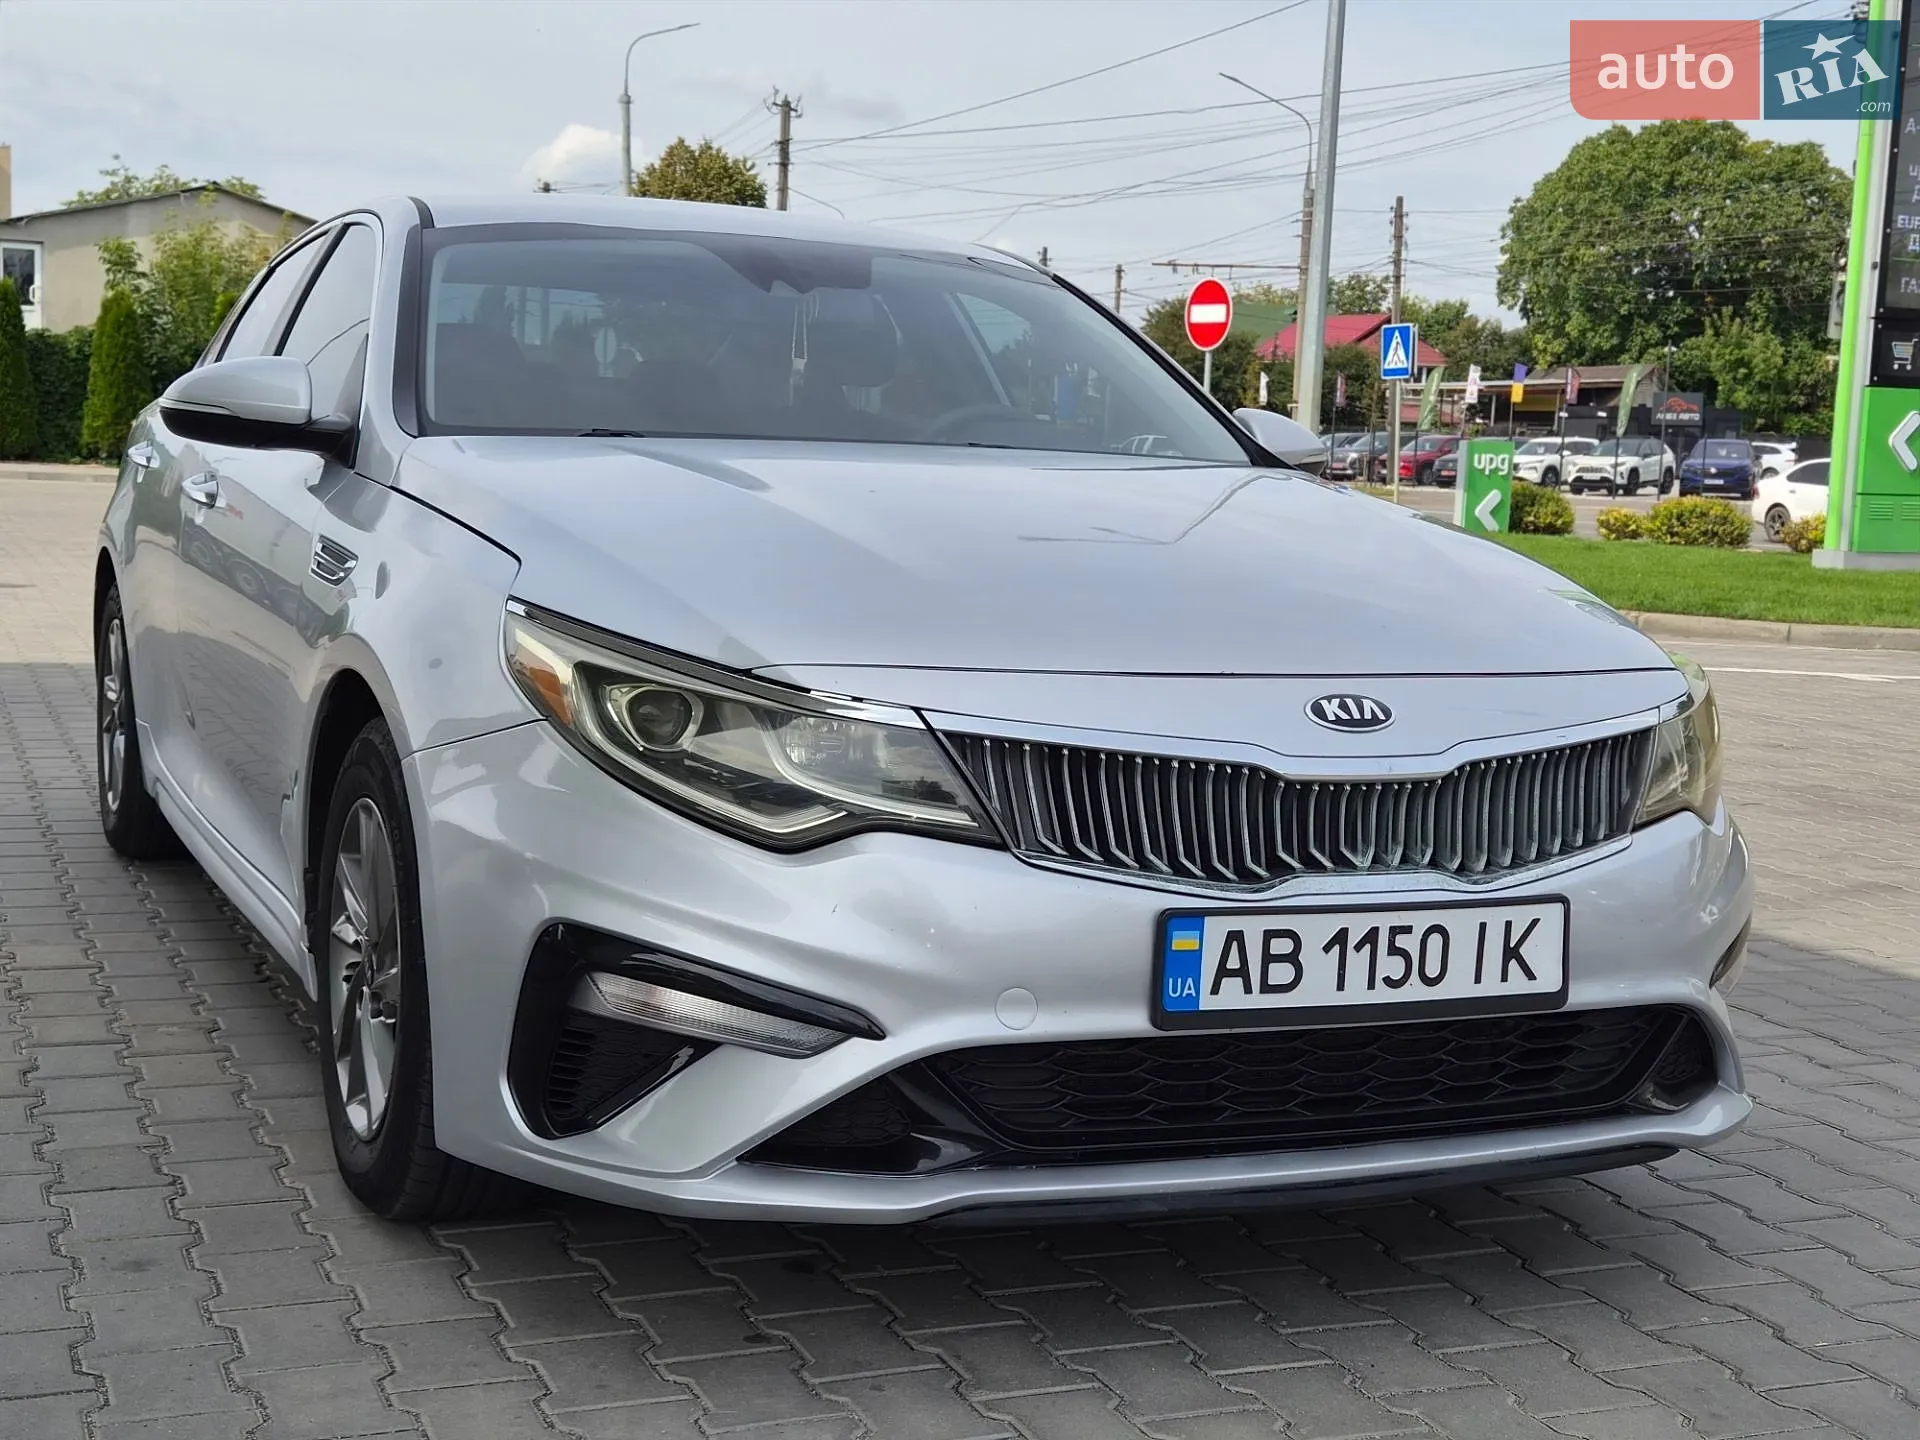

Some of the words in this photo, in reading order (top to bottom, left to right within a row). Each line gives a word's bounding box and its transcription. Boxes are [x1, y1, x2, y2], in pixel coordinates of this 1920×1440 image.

[1474, 453, 1509, 475] upg
[1317, 698, 1386, 721] KIA
[1209, 928, 1303, 995] AB
[1321, 923, 1451, 992] 1150
[1473, 917, 1542, 985] IK
[1168, 977, 1197, 998] UA
